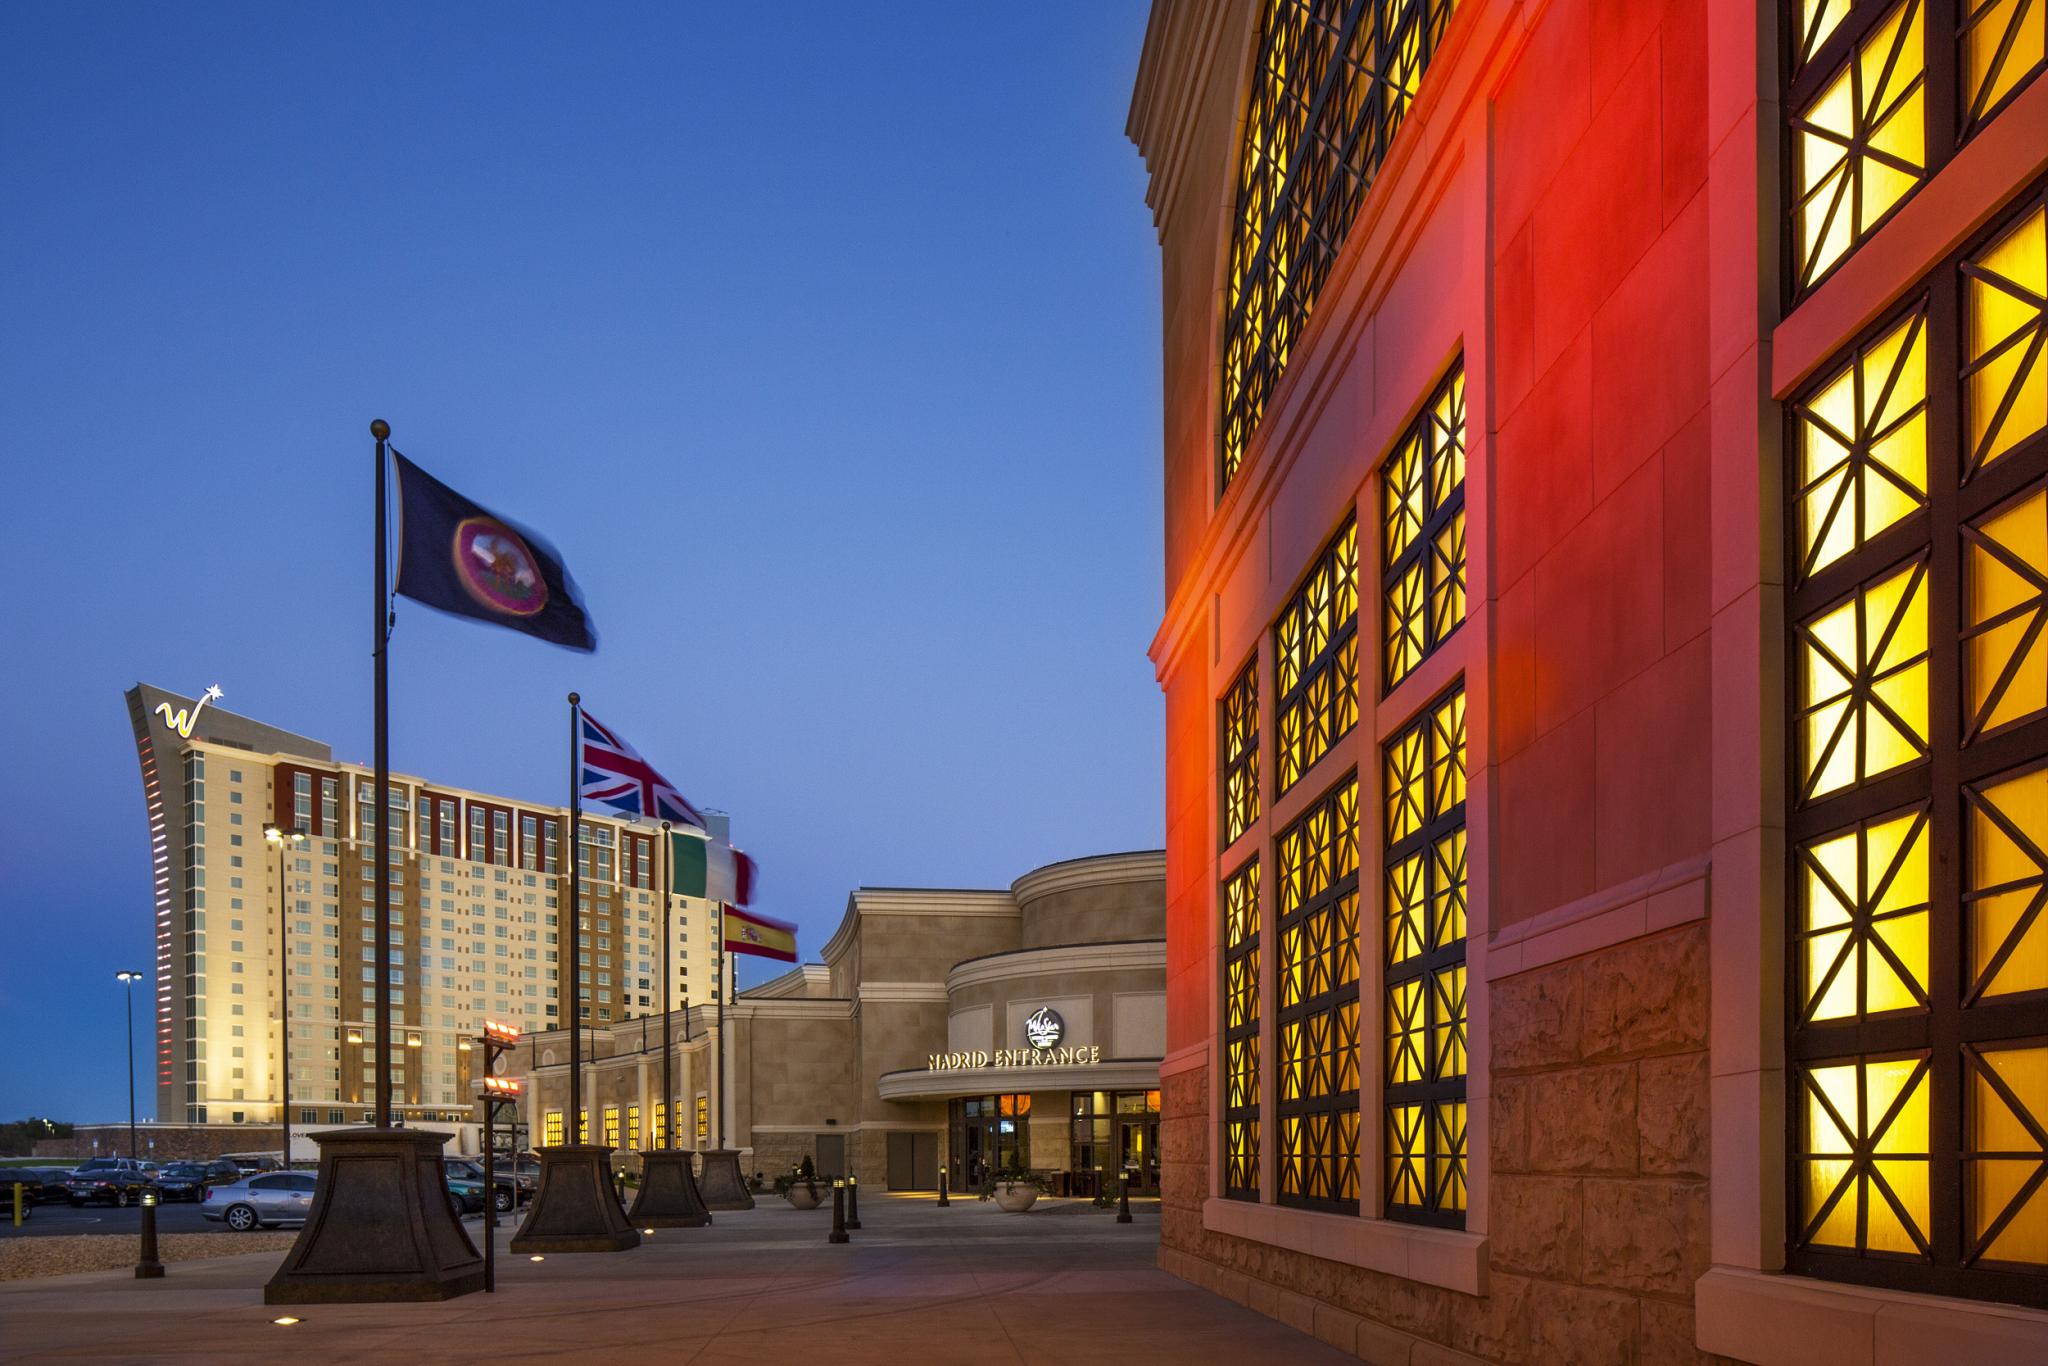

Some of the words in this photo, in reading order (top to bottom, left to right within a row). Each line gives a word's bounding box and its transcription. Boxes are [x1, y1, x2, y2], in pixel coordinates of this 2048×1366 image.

[155, 688, 218, 738] W
[928, 1051, 988, 1070] MADRID
[994, 1046, 1100, 1067] ENTRANCE
